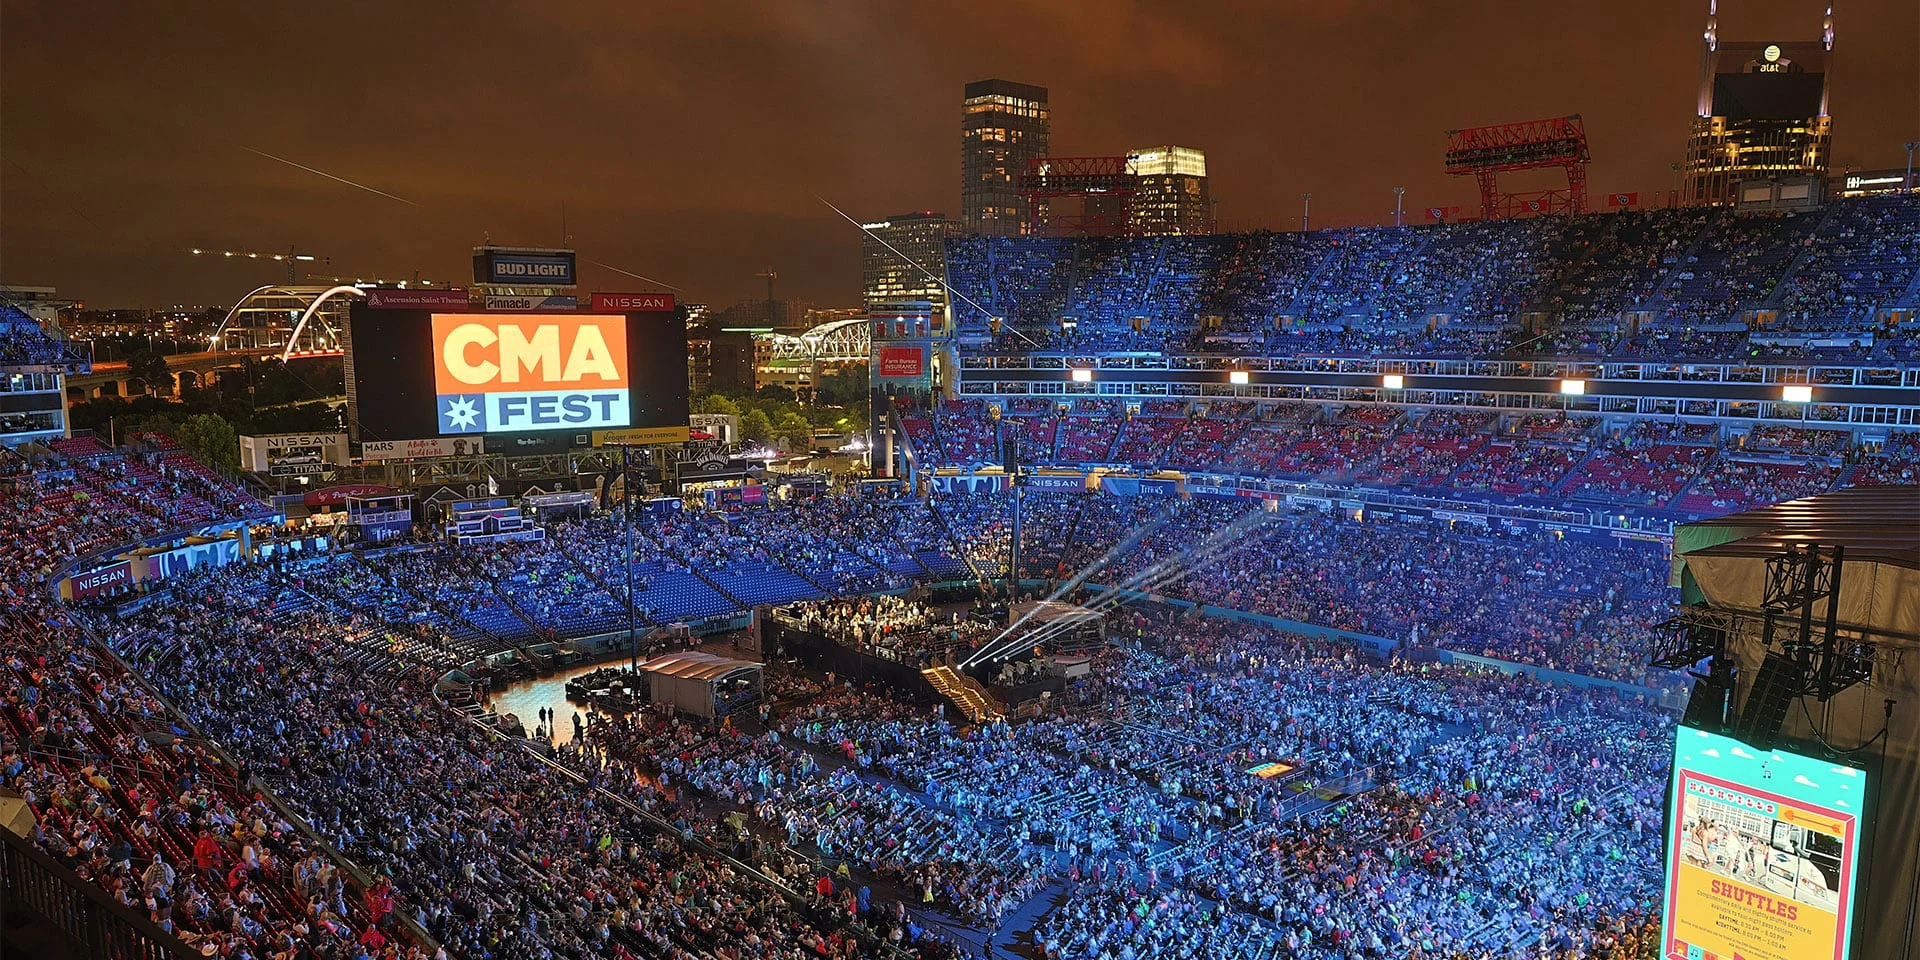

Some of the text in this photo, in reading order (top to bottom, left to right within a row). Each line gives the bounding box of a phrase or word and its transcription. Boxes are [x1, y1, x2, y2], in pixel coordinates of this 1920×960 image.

[496, 263, 567, 277] BUD LIGHT
[383, 296, 468, 305] Ascension Saint Thomas
[487, 297, 530, 309] Pinnacle
[603, 298, 664, 308] NISSAN
[443, 323, 621, 385] CMA
[499, 393, 620, 426] FEST
[692, 416, 729, 426] ISSAN
[267, 435, 336, 447] NISSAN
[603, 431, 626, 442] Kroger
[365, 442, 394, 452] MARS
[697, 440, 717, 448] TITAN
[293, 464, 323, 473] TITAN
[1032, 479, 1079, 488] NISSAN
[79, 569, 125, 590] NISSAN
[1711, 879, 1798, 921] SHUTTLES
